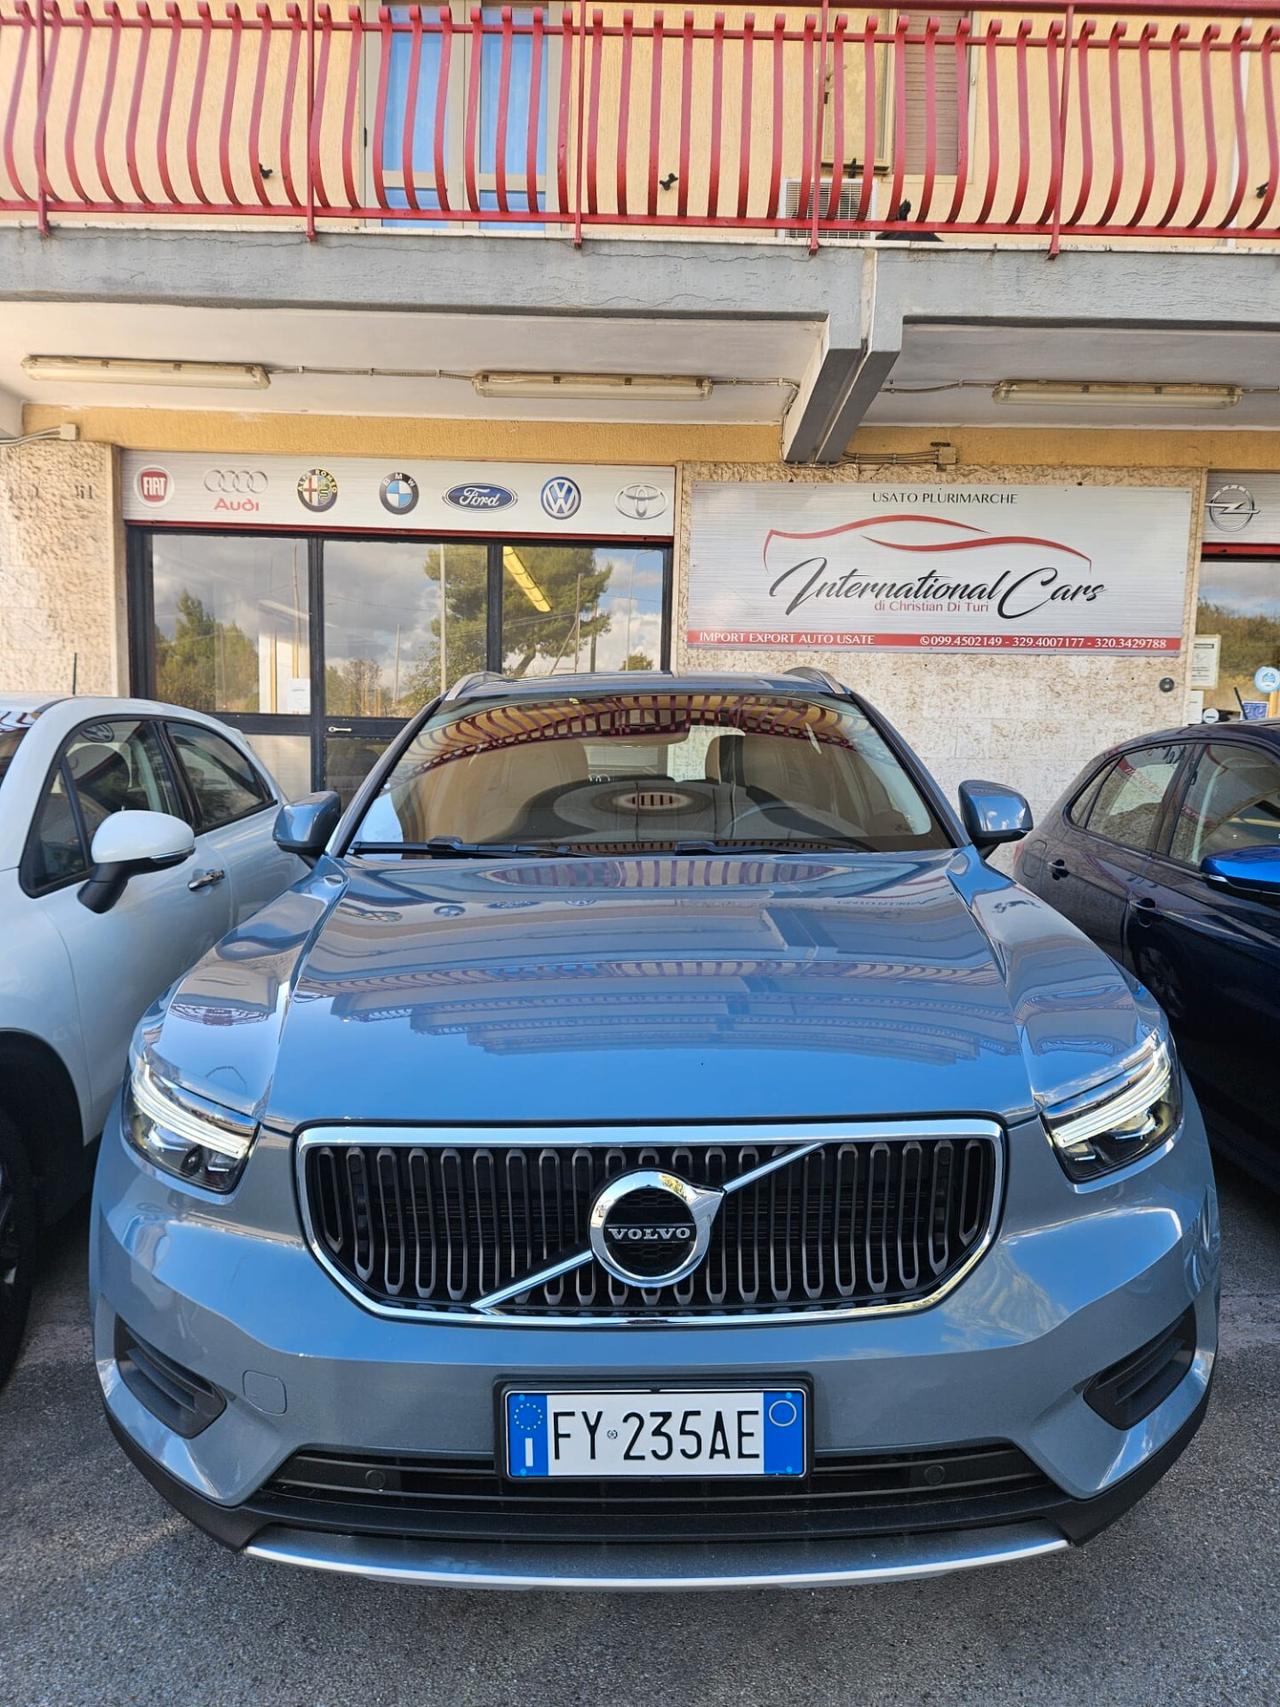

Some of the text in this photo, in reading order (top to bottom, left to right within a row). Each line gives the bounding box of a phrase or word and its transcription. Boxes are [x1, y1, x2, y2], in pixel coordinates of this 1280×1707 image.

[143, 477, 166, 496] FIAT
[315, 469, 337, 493] ROMEO
[459, 487, 500, 506] Ford
[872, 492, 1018, 504] USATO PLURIMARCHE
[213, 498, 259, 512] Audi
[769, 557, 1106, 619] International Cars
[874, 600, 989, 612] di Christian Di Turi
[699, 632, 875, 645] IMPORT EXPORT AUTO USATE
[931, 636, 1002, 647] 099.4502149
[1012, 637, 1085, 648] 329.4007177
[1094, 638, 1167, 649] 320.3429788
[608, 1227, 691, 1240] VOLVO
[553, 1410, 760, 1460] FY 235AE
